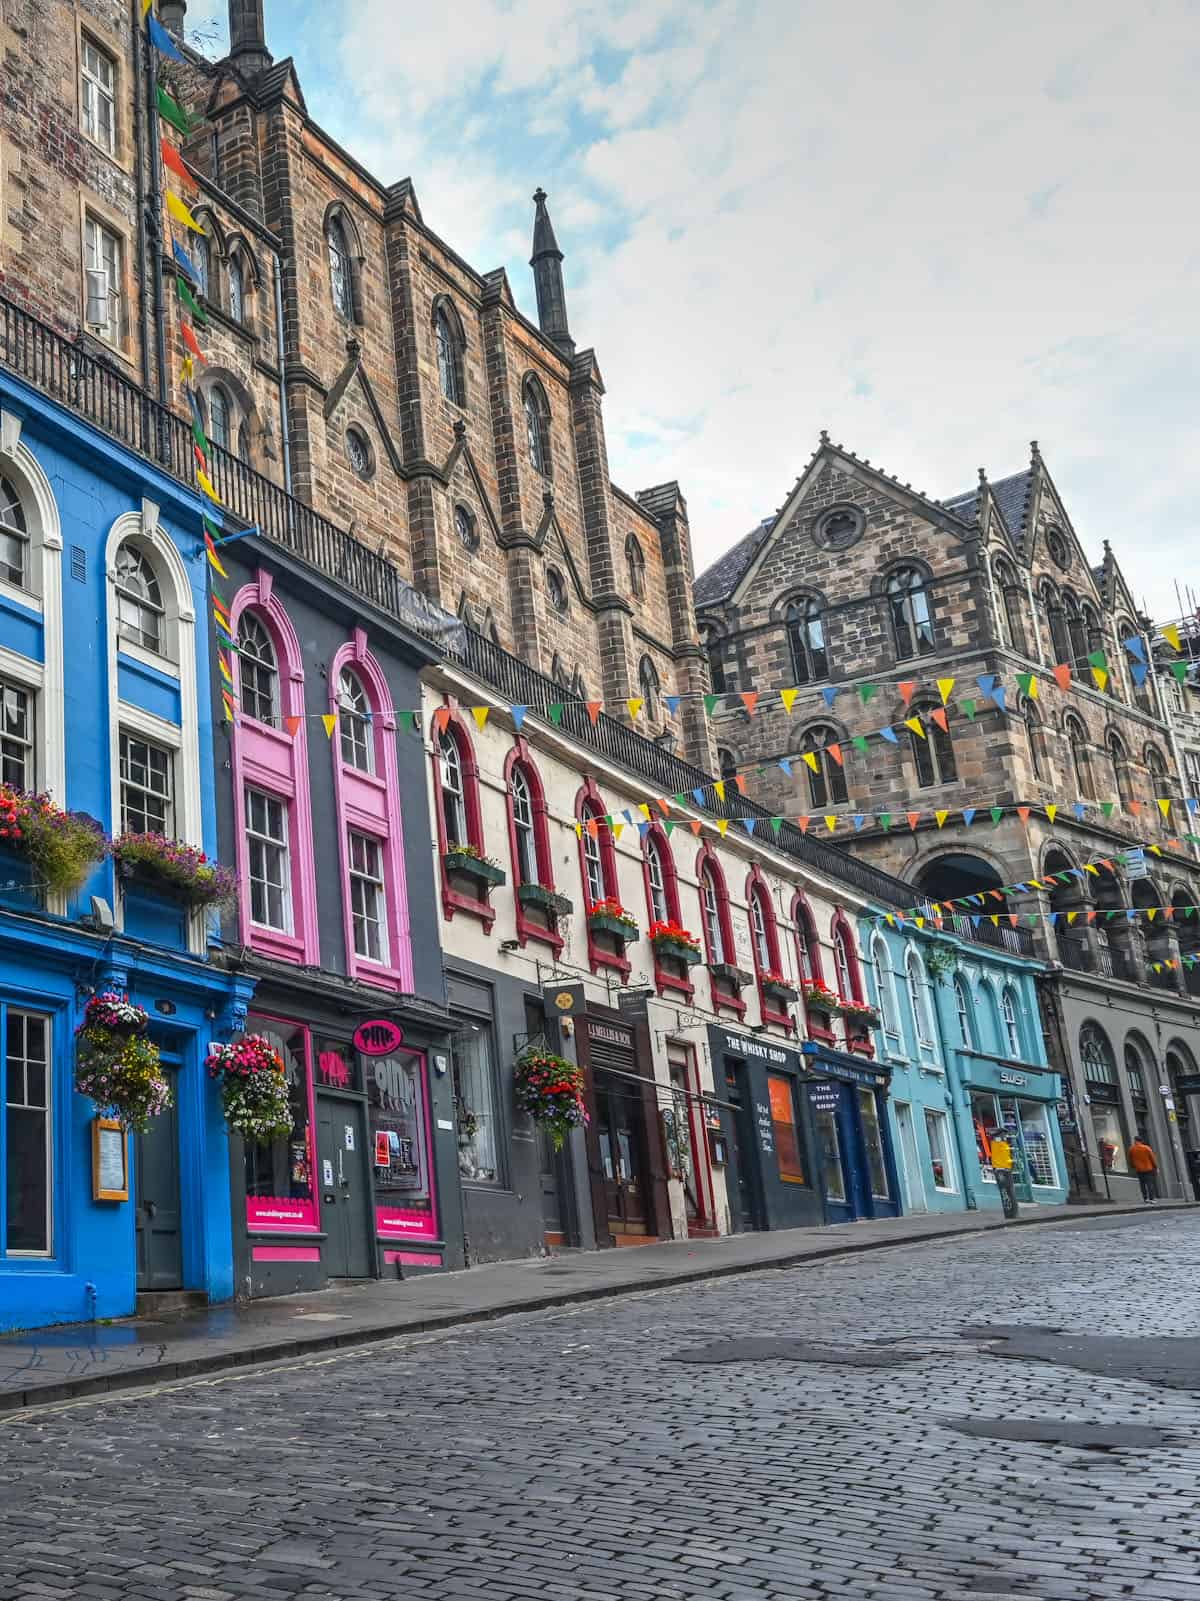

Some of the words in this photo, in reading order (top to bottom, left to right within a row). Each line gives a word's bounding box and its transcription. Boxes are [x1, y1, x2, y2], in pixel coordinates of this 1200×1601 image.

[726, 1036, 741, 1051] THE
[741, 1038, 768, 1059] WHISKY
[769, 1048, 787, 1064] SHOP
[809, 1093, 840, 1102] WHISKY
[815, 1102, 837, 1110] SHOP
